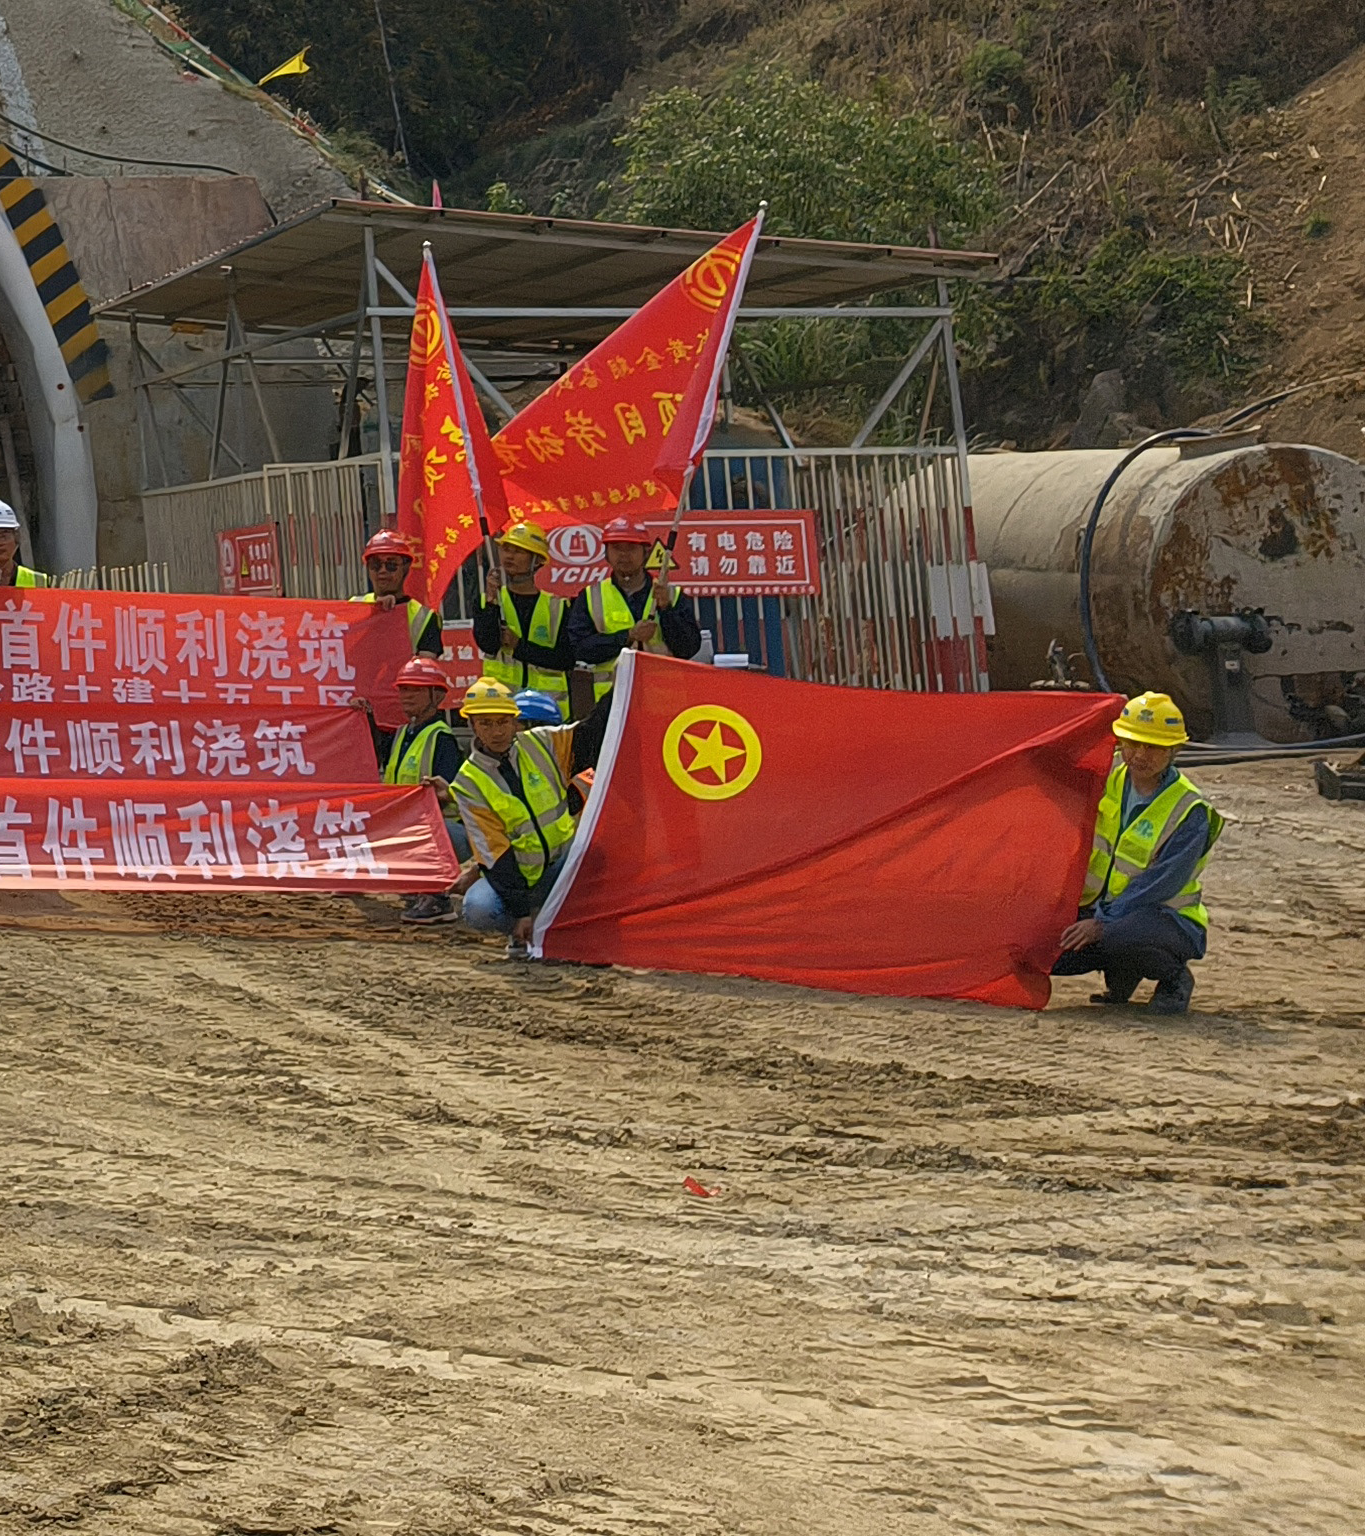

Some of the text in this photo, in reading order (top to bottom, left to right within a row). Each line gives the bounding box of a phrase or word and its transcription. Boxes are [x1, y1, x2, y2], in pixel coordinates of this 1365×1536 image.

[687, 531, 794, 552] 有电危险
[550, 567, 608, 583] YCIH
[690, 555, 796, 576] 请勿靠近
